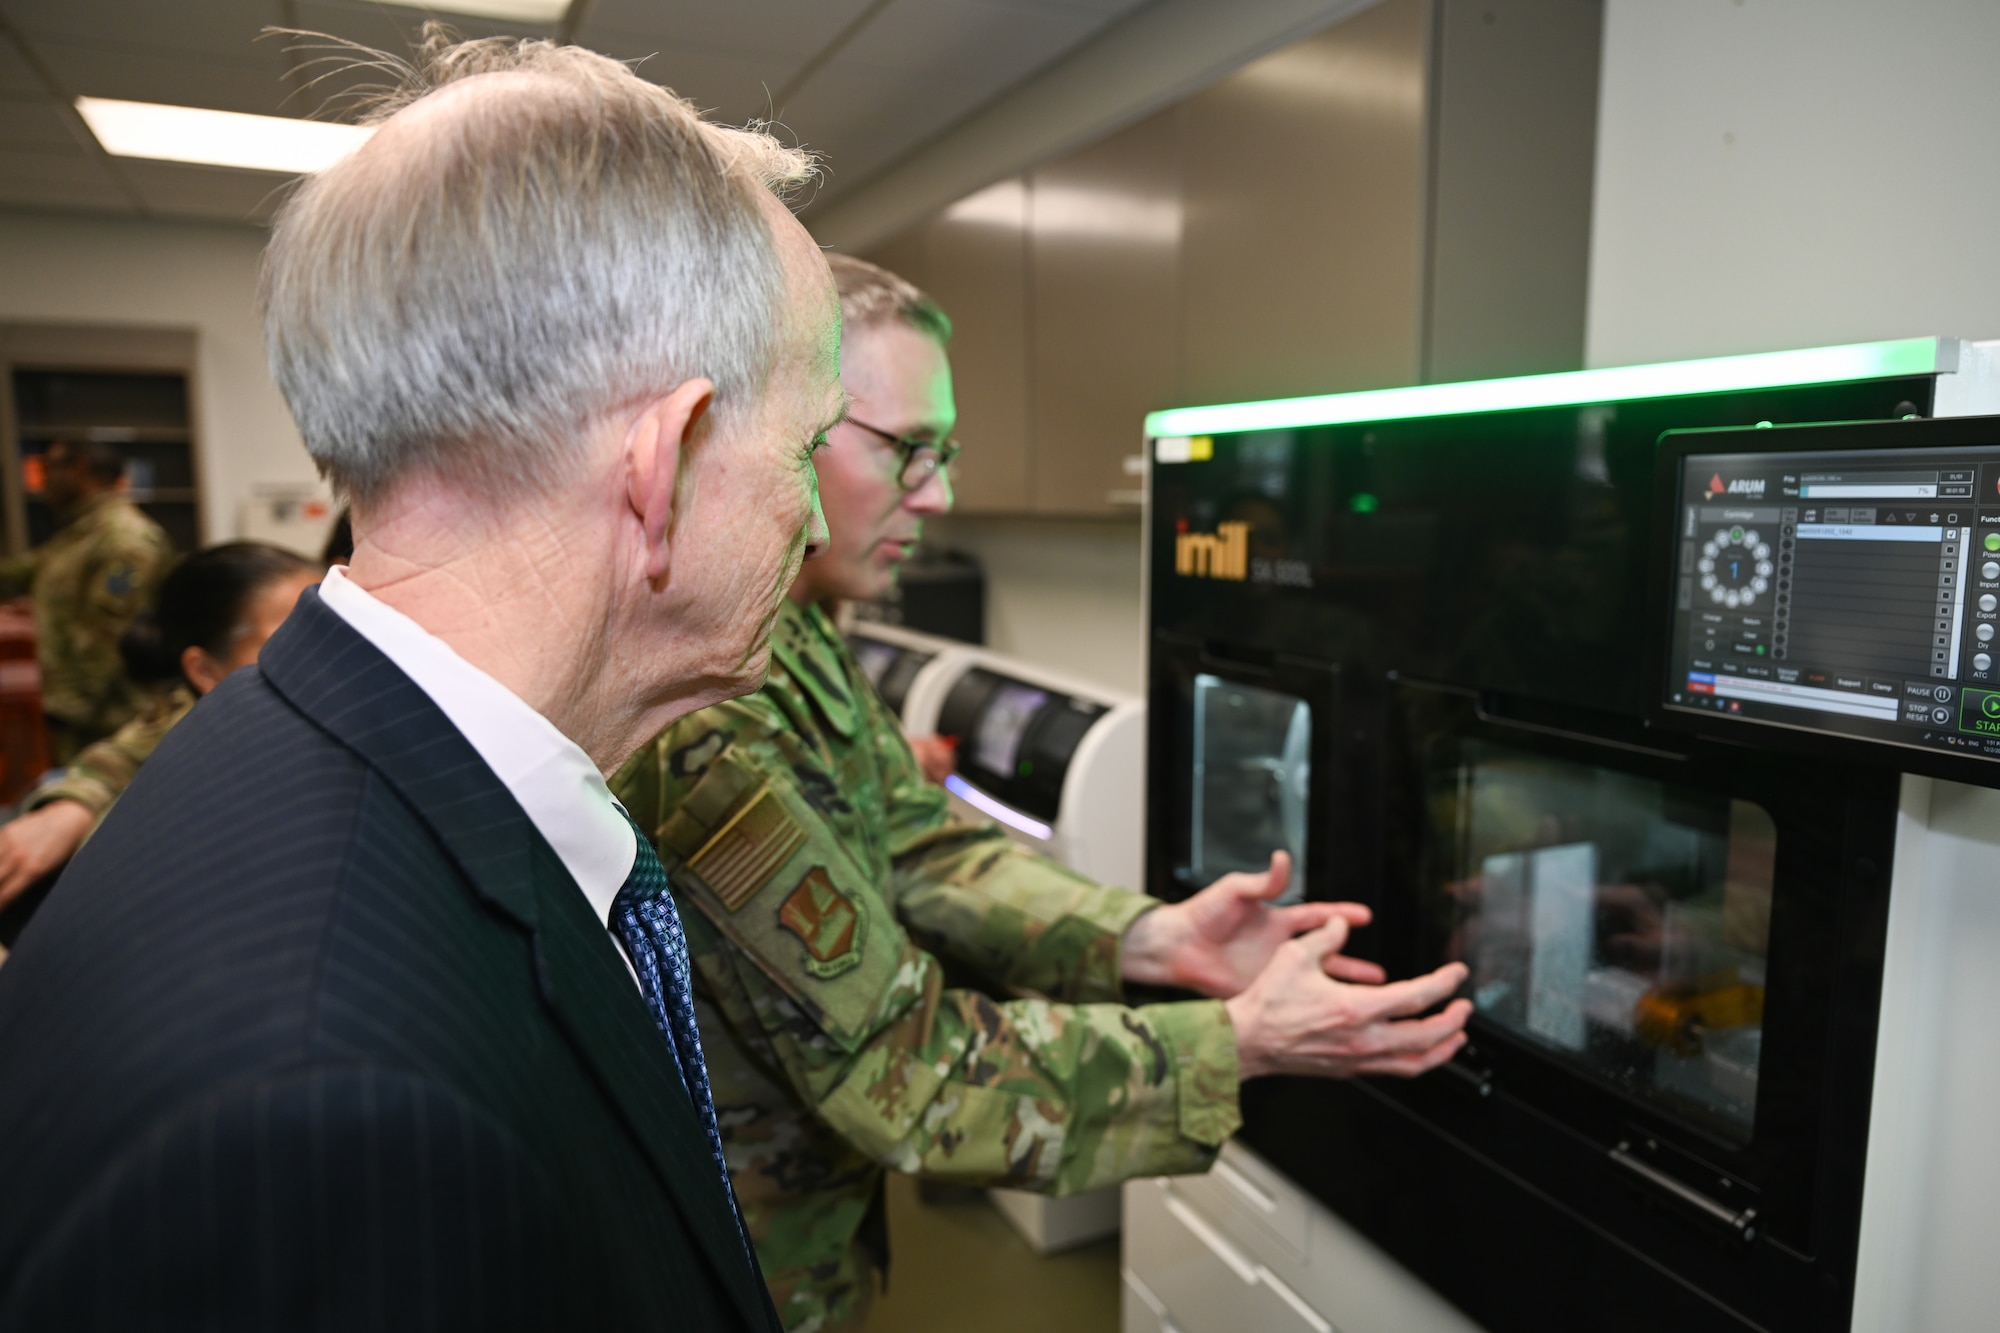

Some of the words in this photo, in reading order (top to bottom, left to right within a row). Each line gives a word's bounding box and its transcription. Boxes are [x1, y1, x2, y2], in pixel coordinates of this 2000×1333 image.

[1727, 479, 1766, 494] ARUM
[1783, 487, 1799, 495] Time
[1918, 487, 1930, 495] 7%
[1175, 518, 1249, 581] imill
[1979, 581, 2000, 589] Import
[1976, 611, 1997, 620] Export
[1977, 642, 1989, 650] Dry
[1973, 671, 1988, 680] ATC
[1837, 677, 1861, 688] Support
[1872, 683, 1893, 692] Clamp
[1907, 686, 1931, 697] PAUSE
[1908, 704, 1929, 713] STOP
[1906, 712, 1929, 722] RESET
